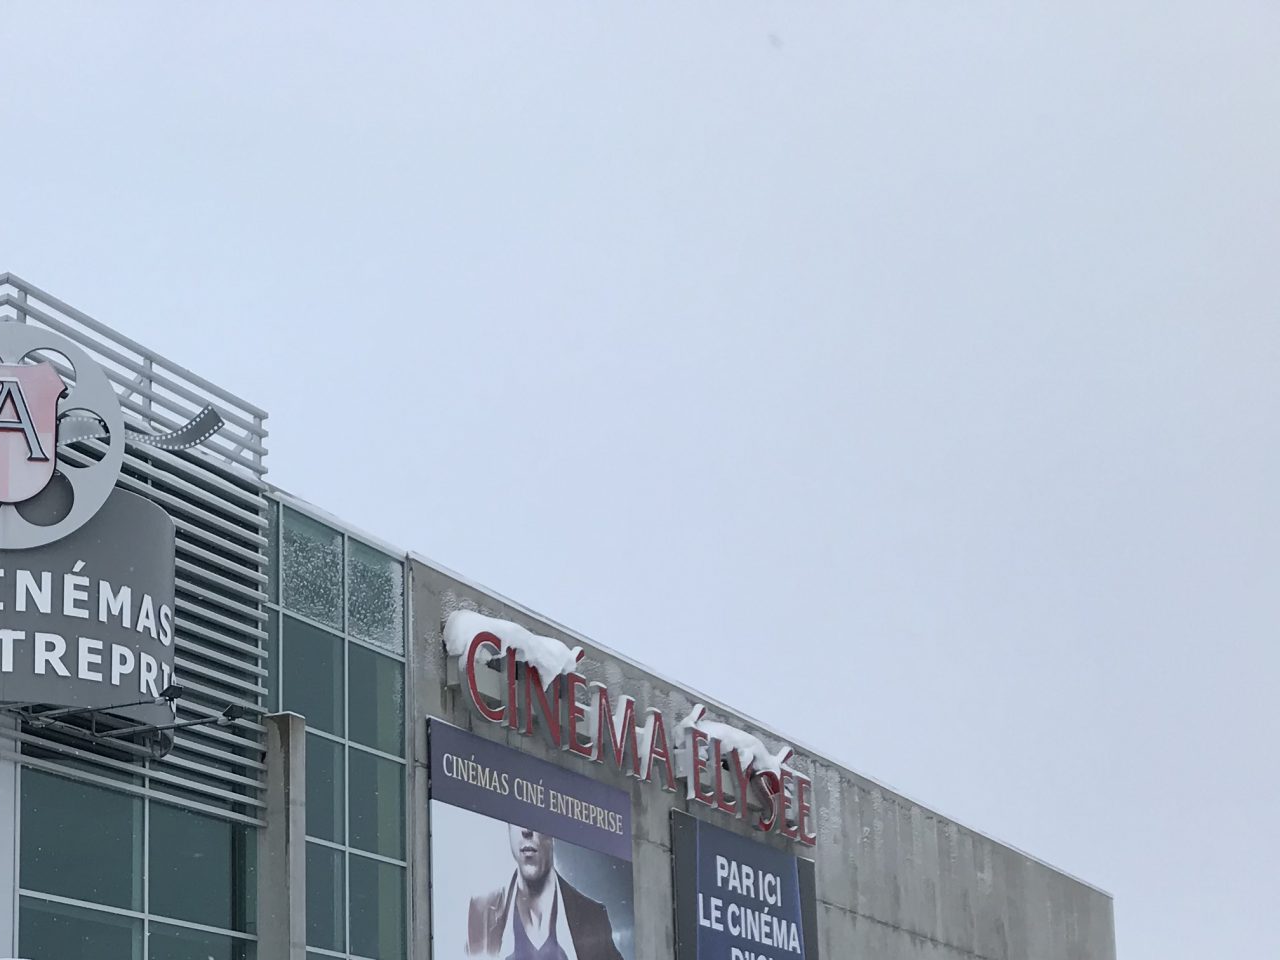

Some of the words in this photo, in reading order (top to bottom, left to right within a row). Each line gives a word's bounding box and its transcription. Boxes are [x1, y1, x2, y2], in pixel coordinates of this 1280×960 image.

[464, 630, 677, 792] CINÉMA
[442, 752, 510, 796] CINÉMAS
[513, 778, 546, 809] CINÉ
[548, 789, 624, 836] ENTREPRISE
[715, 854, 756, 899] PAR
[758, 869, 783, 907] ICI
[697, 892, 725, 932] LE
[727, 902, 802, 954] CINÉMA
